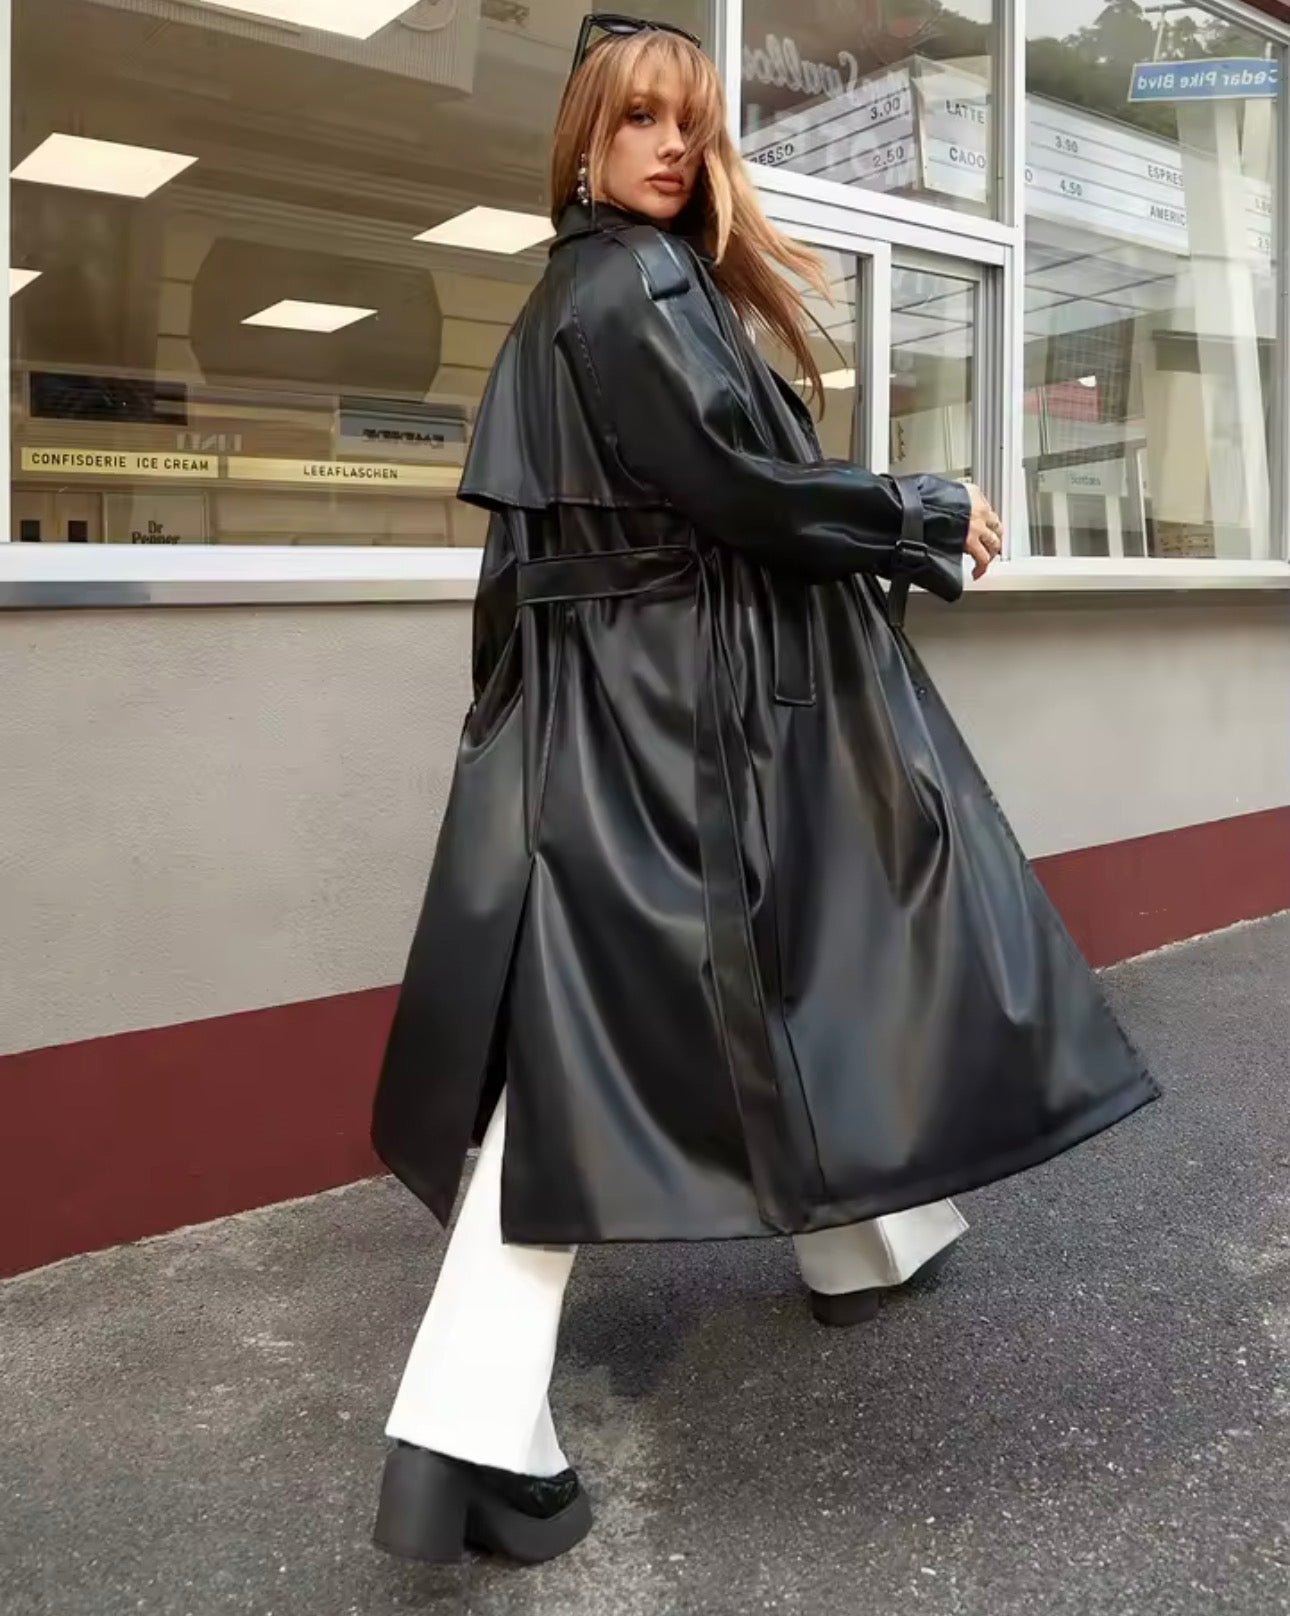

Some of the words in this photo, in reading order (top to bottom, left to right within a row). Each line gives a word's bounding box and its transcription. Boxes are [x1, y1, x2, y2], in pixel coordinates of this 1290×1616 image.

[870, 97, 901, 120] 3.00
[946, 100, 985, 124] LATTE
[872, 146, 905, 167] 2.50
[137, 457, 158, 469] ICE
[164, 458, 209, 471] CREAM
[148, 520, 164, 534] Dr
